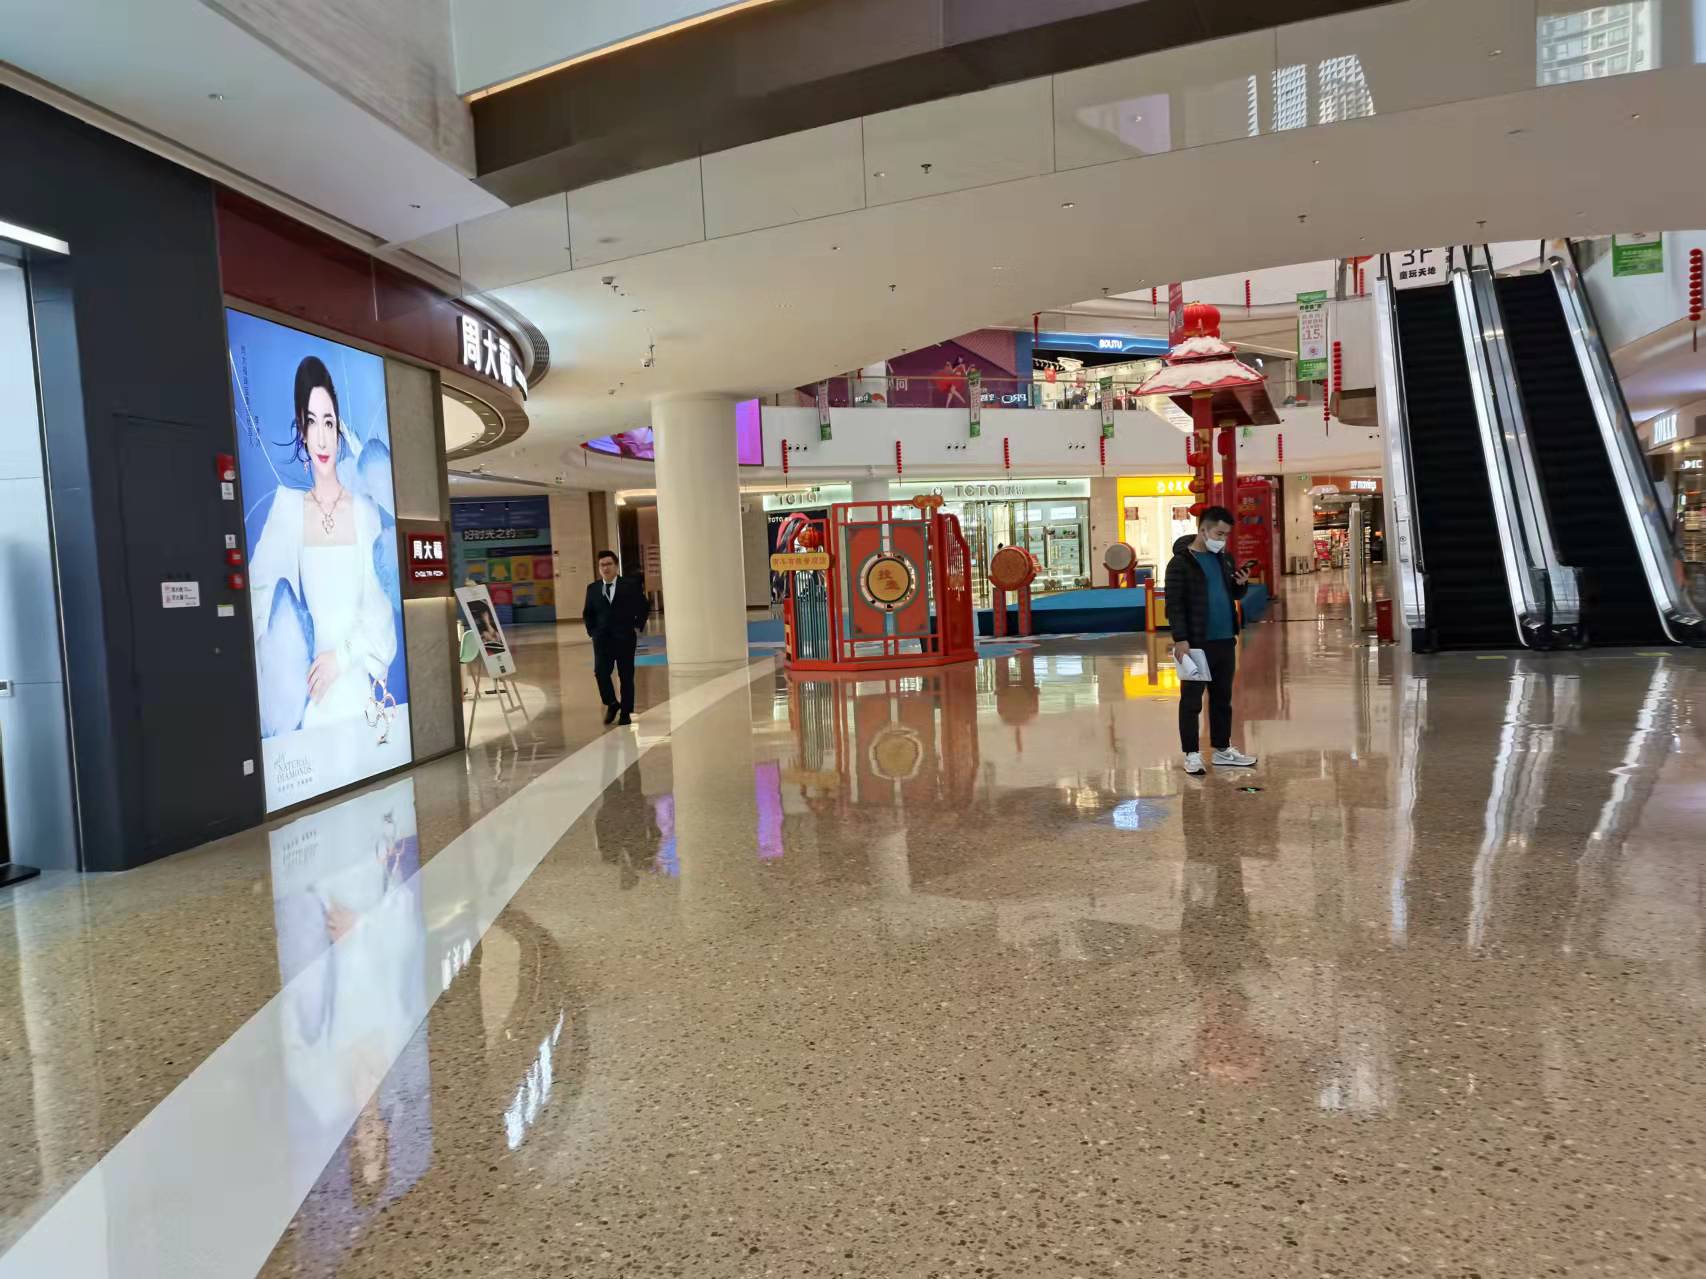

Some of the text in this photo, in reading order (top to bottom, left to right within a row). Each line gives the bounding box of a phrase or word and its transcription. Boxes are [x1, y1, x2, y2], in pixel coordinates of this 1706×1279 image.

[462, 314, 513, 388] 周大福
[413, 540, 443, 559] 周大福
